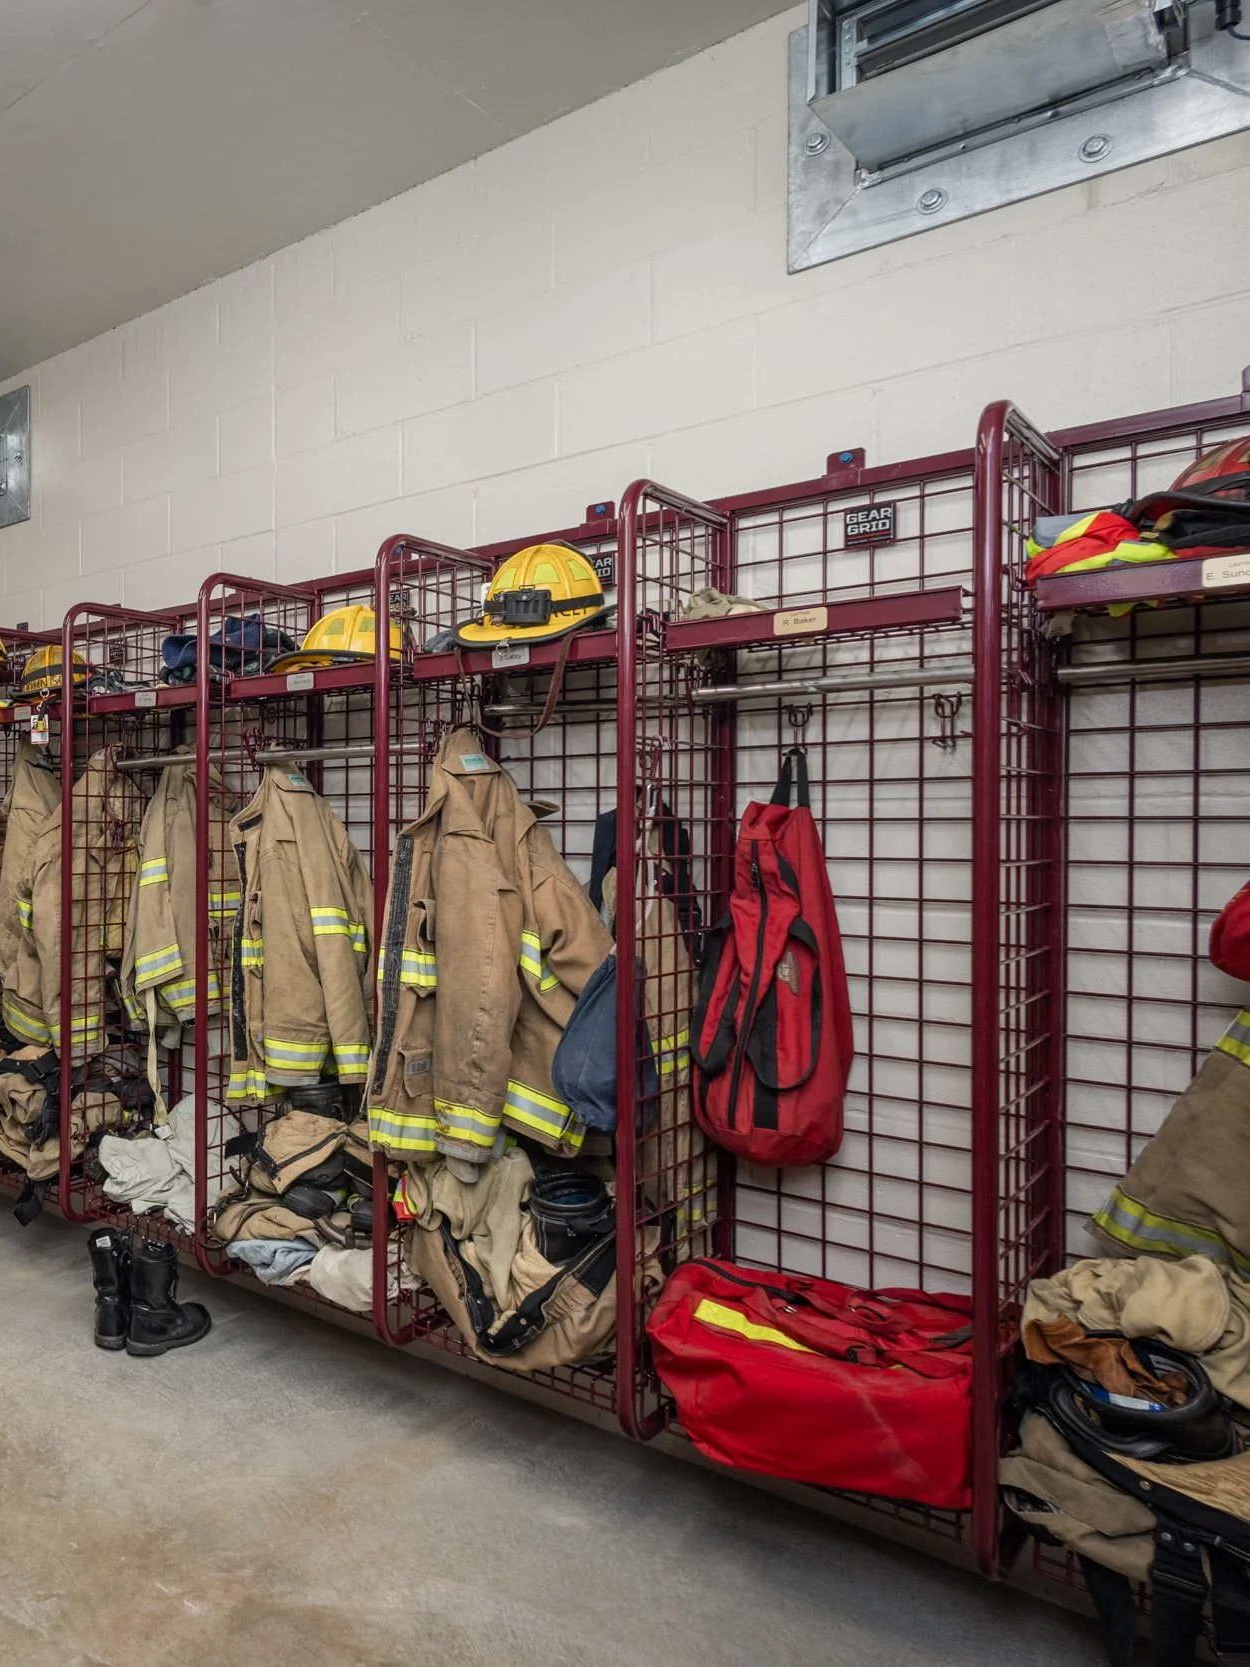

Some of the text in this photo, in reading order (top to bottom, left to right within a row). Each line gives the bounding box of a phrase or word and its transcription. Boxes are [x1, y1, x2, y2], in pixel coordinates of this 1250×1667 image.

[846, 507, 891, 524] GEAR
[847, 519, 890, 535] GRID
[793, 617, 816, 625] Baker
